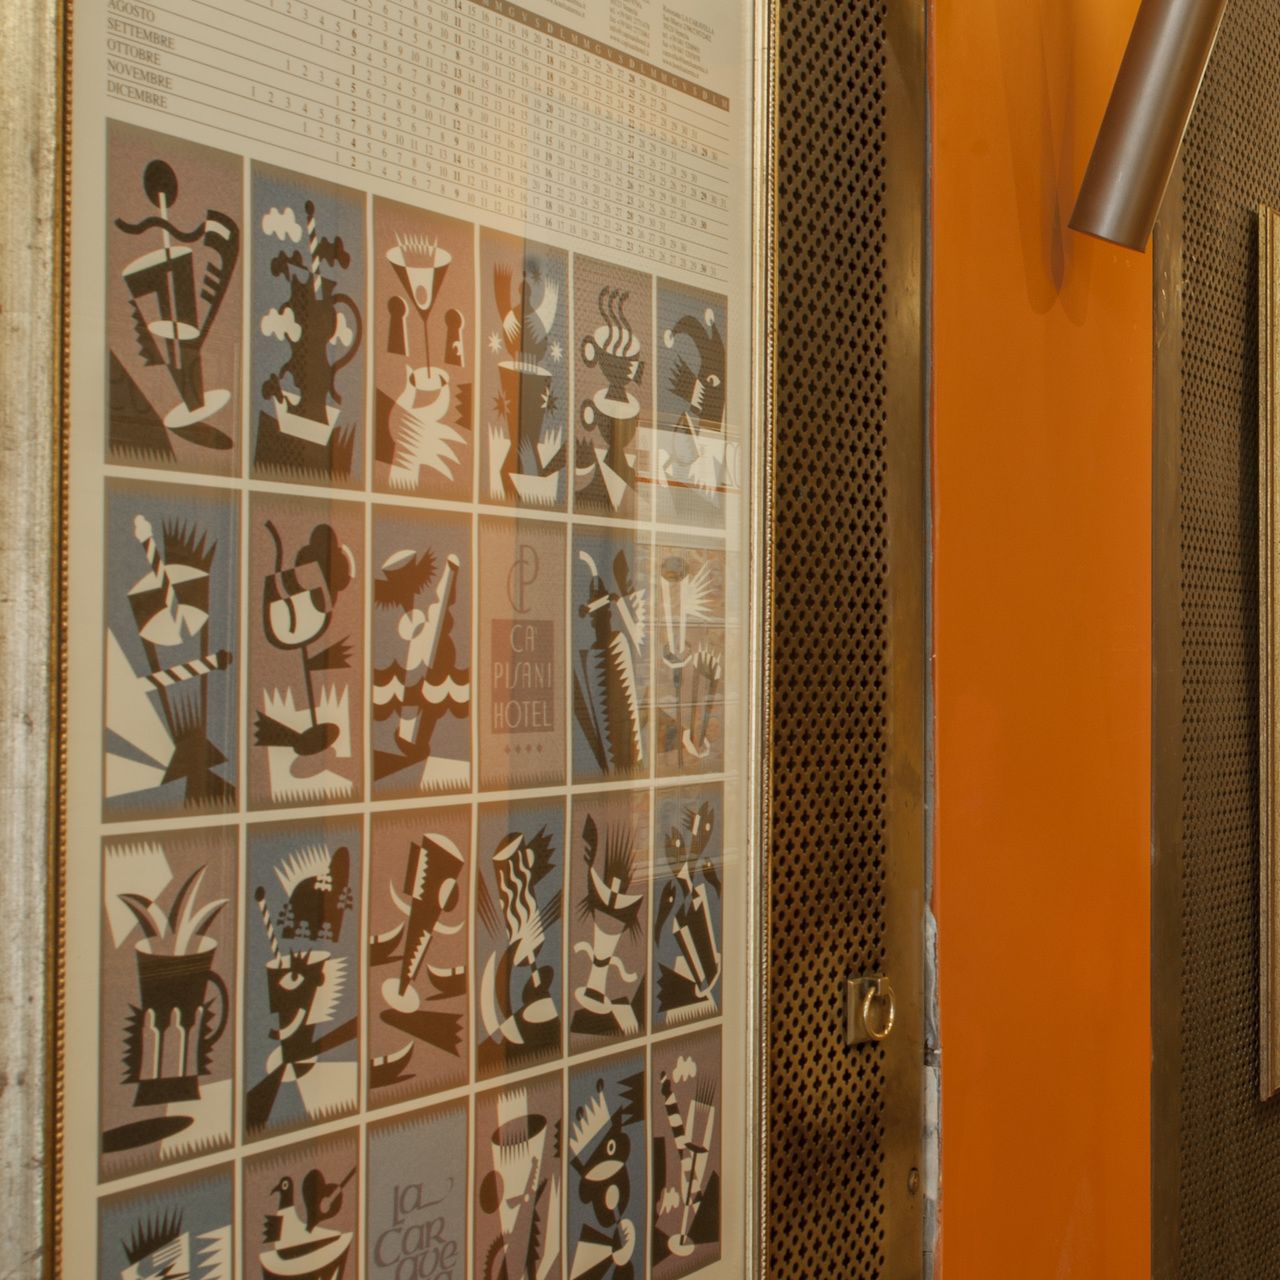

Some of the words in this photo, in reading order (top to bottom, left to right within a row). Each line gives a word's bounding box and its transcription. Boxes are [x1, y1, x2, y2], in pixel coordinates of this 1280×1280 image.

[106, 17, 176, 50] SETTEMBRE
[106, 38, 162, 67] OTTOBRE
[106, 59, 173, 91] NOVEMBRE
[106, 79, 169, 109] DICEMBRE
[494, 662, 553, 690] PISANI
[494, 700, 553, 730] HOTEL
